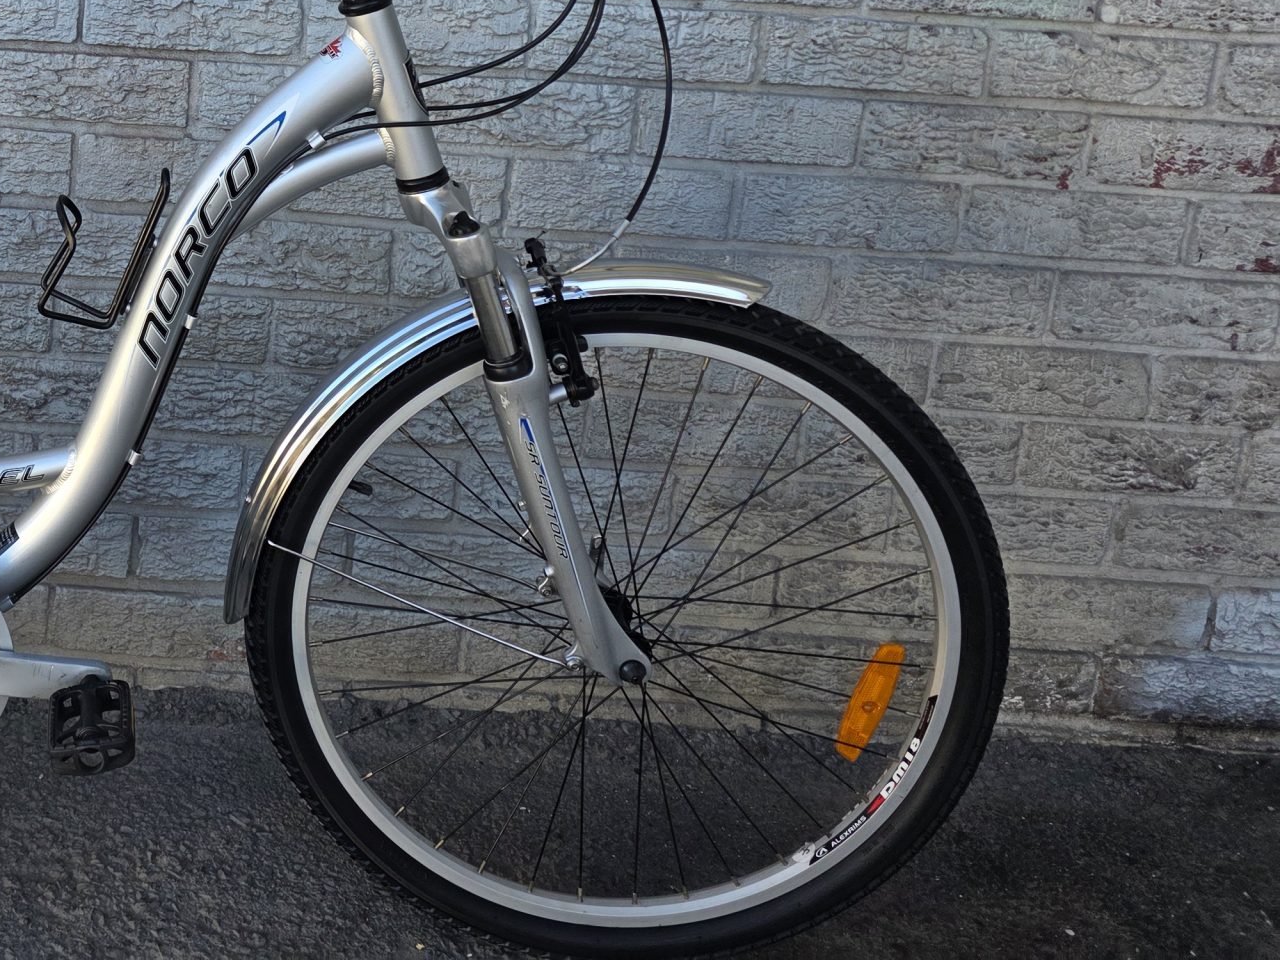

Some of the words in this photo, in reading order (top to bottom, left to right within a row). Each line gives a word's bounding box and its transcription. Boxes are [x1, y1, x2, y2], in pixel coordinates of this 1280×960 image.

[524, 442, 541, 466] SR
[536, 474, 569, 559] SUNTOUR
[831, 815, 867, 848] ALEXRIMS
